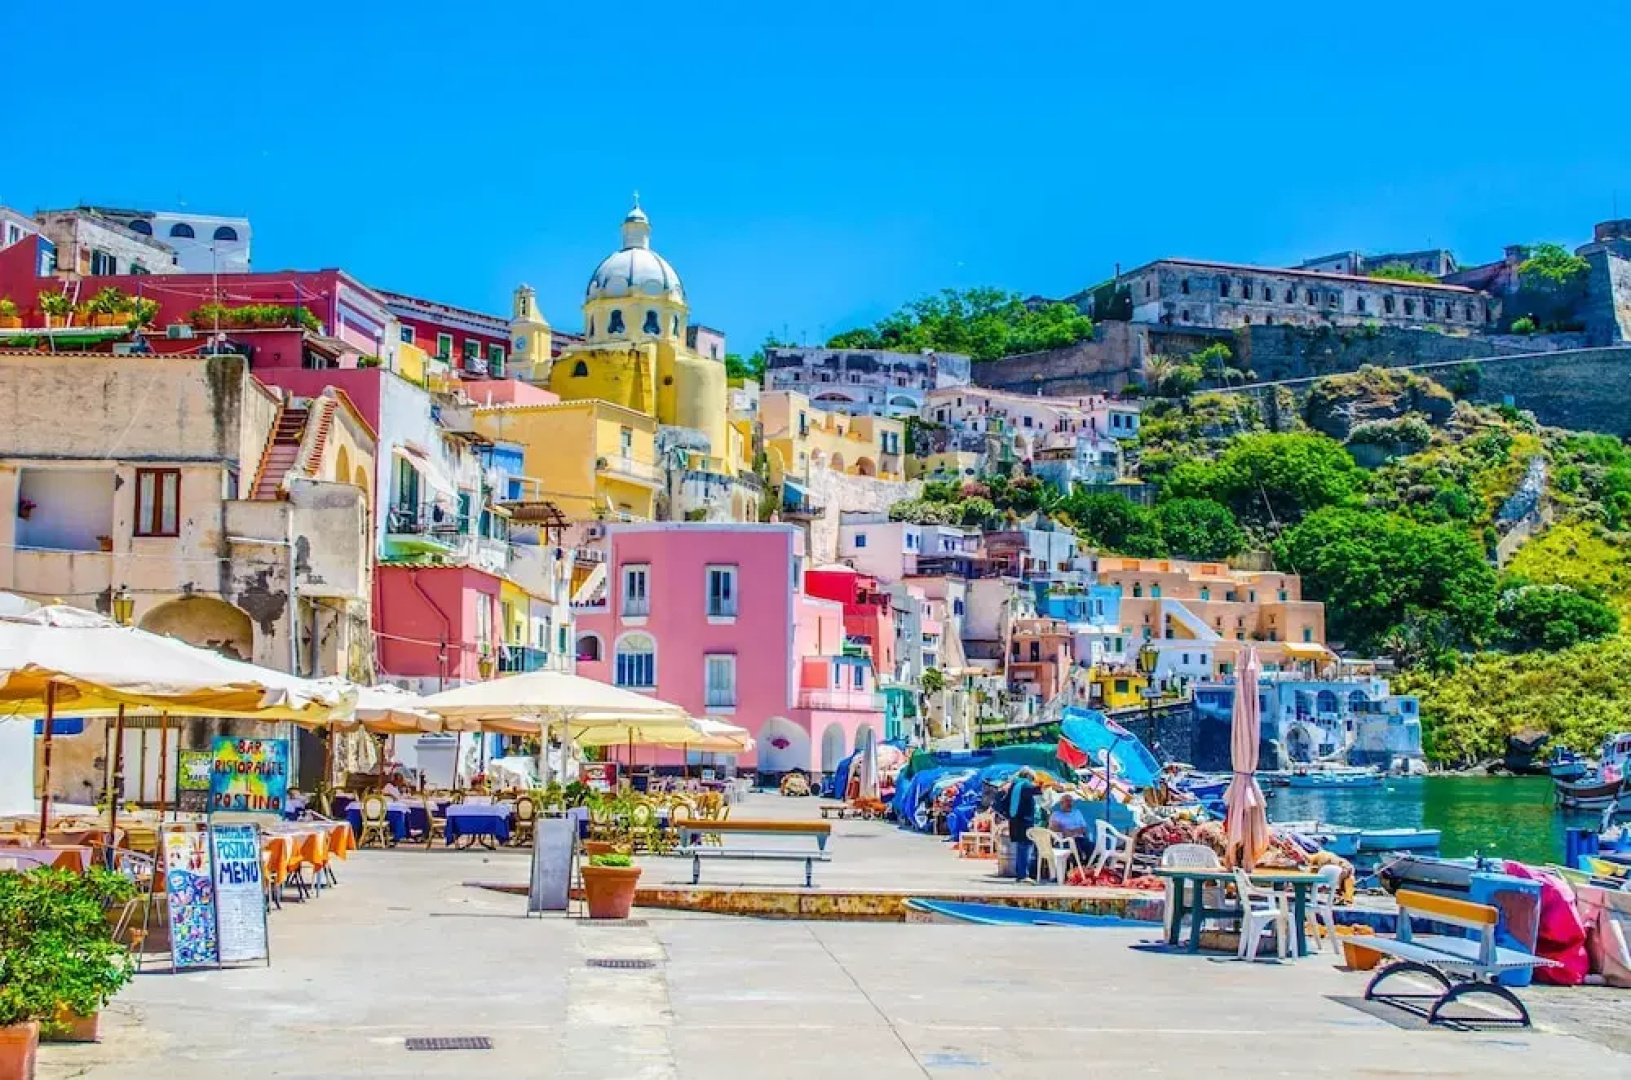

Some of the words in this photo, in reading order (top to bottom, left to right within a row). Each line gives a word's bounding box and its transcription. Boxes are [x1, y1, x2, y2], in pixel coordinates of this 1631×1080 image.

[238, 739, 262, 755] BAR
[214, 759, 284, 776] RISTORANTE
[214, 793, 281, 810] POSTINO
[216, 841, 255, 859] POSTINO
[219, 860, 258, 884] MENU
